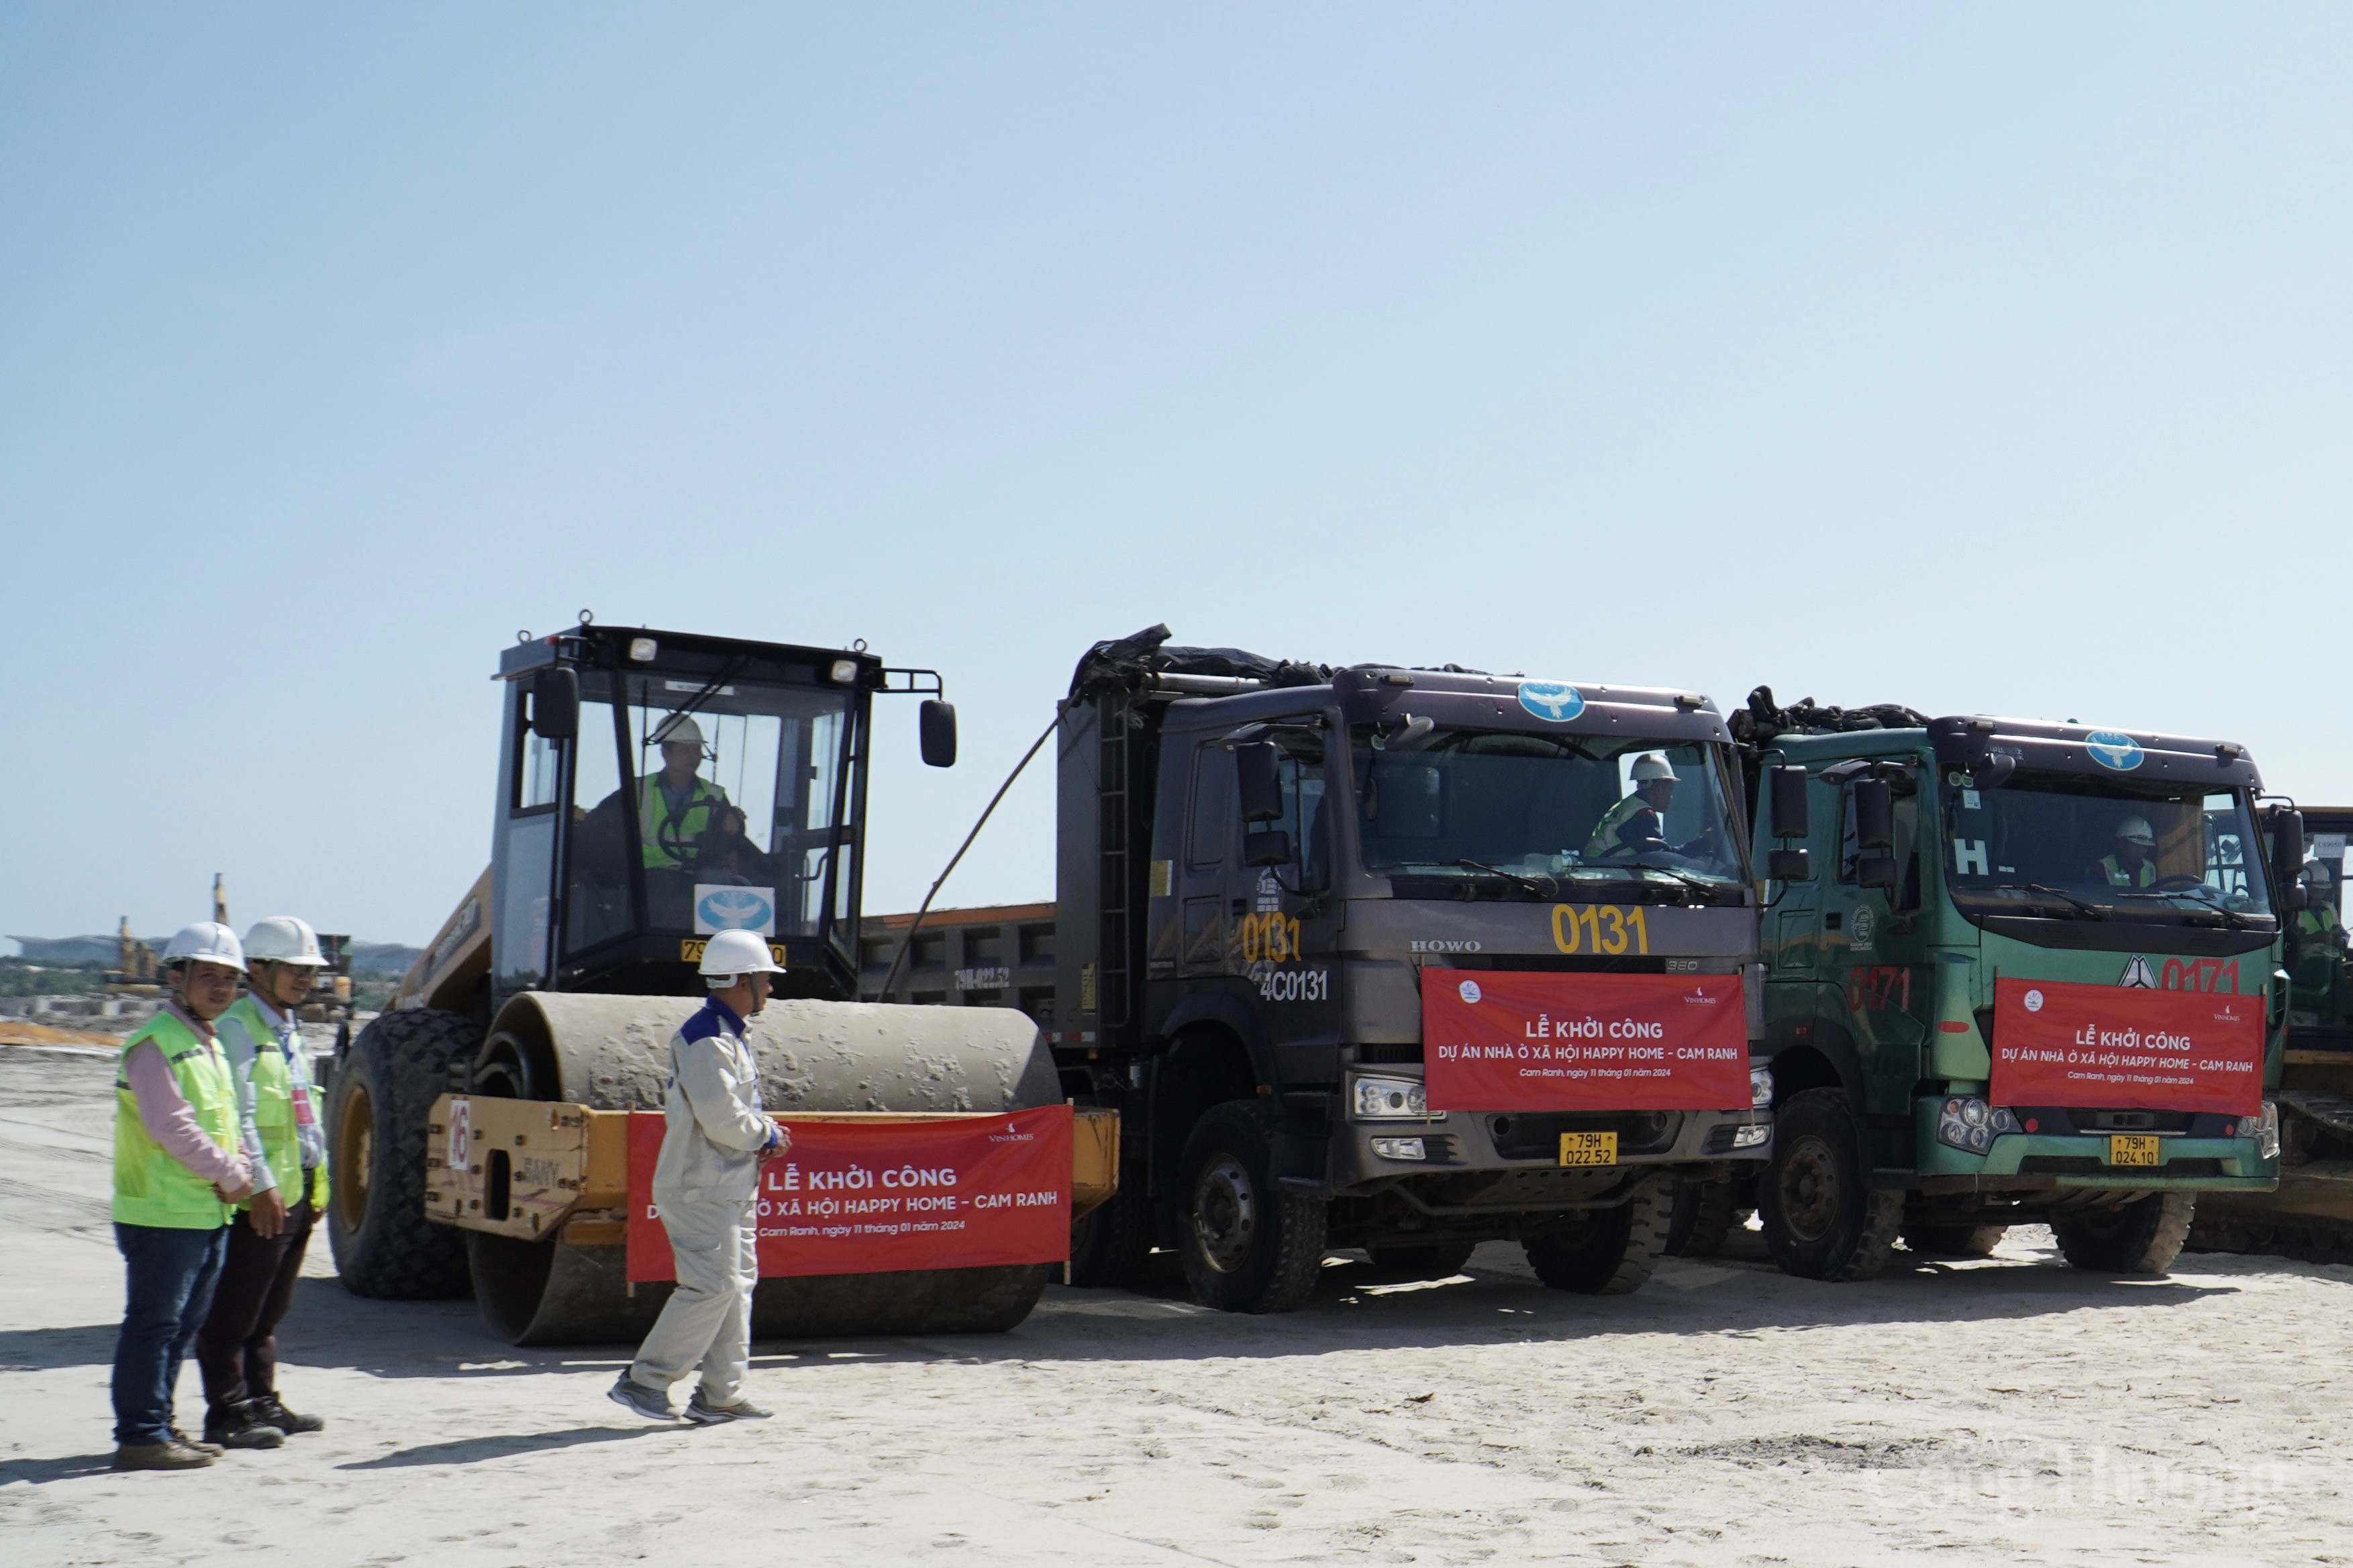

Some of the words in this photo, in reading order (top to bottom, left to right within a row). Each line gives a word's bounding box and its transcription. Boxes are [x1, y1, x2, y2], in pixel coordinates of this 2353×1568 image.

[1243, 911, 1302, 963] 0131
[1552, 904, 1648, 954] 0131
[1410, 939, 1482, 952] HOWO
[1666, 960, 1698, 970] 380
[2161, 958, 2239, 994] 0171
[1260, 970, 1328, 1001] 4C0131
[1848, 965, 1910, 1011] 0171
[1526, 1014, 1550, 1037] LỄ
[1556, 1016, 1603, 1038] KHỞI
[1609, 1018, 1662, 1038] CÔNG
[2076, 1024, 2096, 1045] LỄ
[2101, 1027, 2140, 1047] KHỞI
[2145, 1031, 2190, 1050] CÔNG
[1439, 1045, 1458, 1061] DỰ
[1461, 1043, 1481, 1058] ÁN
[1485, 1043, 1514, 1058] NHÀ
[1518, 1043, 1529, 1058] Ở
[1532, 1045, 1550, 1059] XÃ
[1556, 1045, 1579, 1063] HỘI
[1583, 1047, 1624, 1059] HAPPY
[1629, 1047, 1664, 1059] HOME
[1677, 1048, 1704, 1059] CAM
[1707, 1048, 1737, 1059] RANH
[2002, 1048, 2018, 1063] DỰ
[2020, 1047, 2038, 1060] ÁN
[2040, 1049, 2064, 1062] NHÀ
[2068, 1049, 2077, 1063] Ở
[2080, 1051, 2095, 1064] XÃ
[2099, 1052, 2119, 1068] HỘI
[2121, 1055, 2157, 1067] HAPPY
[2159, 1057, 2190, 1069] HOME
[2199, 1059, 2223, 1071] CAM
[2226, 1061, 2252, 1072] RANH
[1542, 1069, 1565, 1077] Ranh,
[1566, 1069, 1589, 1079] ngày
[1598, 1069, 1622, 1079] tháng
[1632, 1068, 1652, 1076] năm
[1577, 1134, 1602, 1148] 79H
[2125, 1137, 2146, 1149] 79H
[1566, 1149, 1611, 1164] 022.52
[768, 1163, 799, 1190] LỄ
[809, 1164, 872, 1190] KHỞI
[882, 1165, 956, 1188] CÔNG
[777, 1198, 801, 1216] XÃ
[807, 1197, 839, 1218] HỘI
[845, 1198, 901, 1213] HAPPY
[907, 1196, 956, 1211] HOME
[974, 1194, 1011, 1208] CAM
[1017, 1192, 1056, 1206] RANH
[759, 1228, 787, 1237] Cam
[789, 1226, 819, 1236] Ranh,
[822, 1224, 851, 1237] ngày
[854, 1224, 862, 1233] 11
[864, 1223, 898, 1235] tháng
[900, 1222, 911, 1232] 01
[913, 1221, 938, 1231] năm
[941, 1220, 965, 1230] 2024
